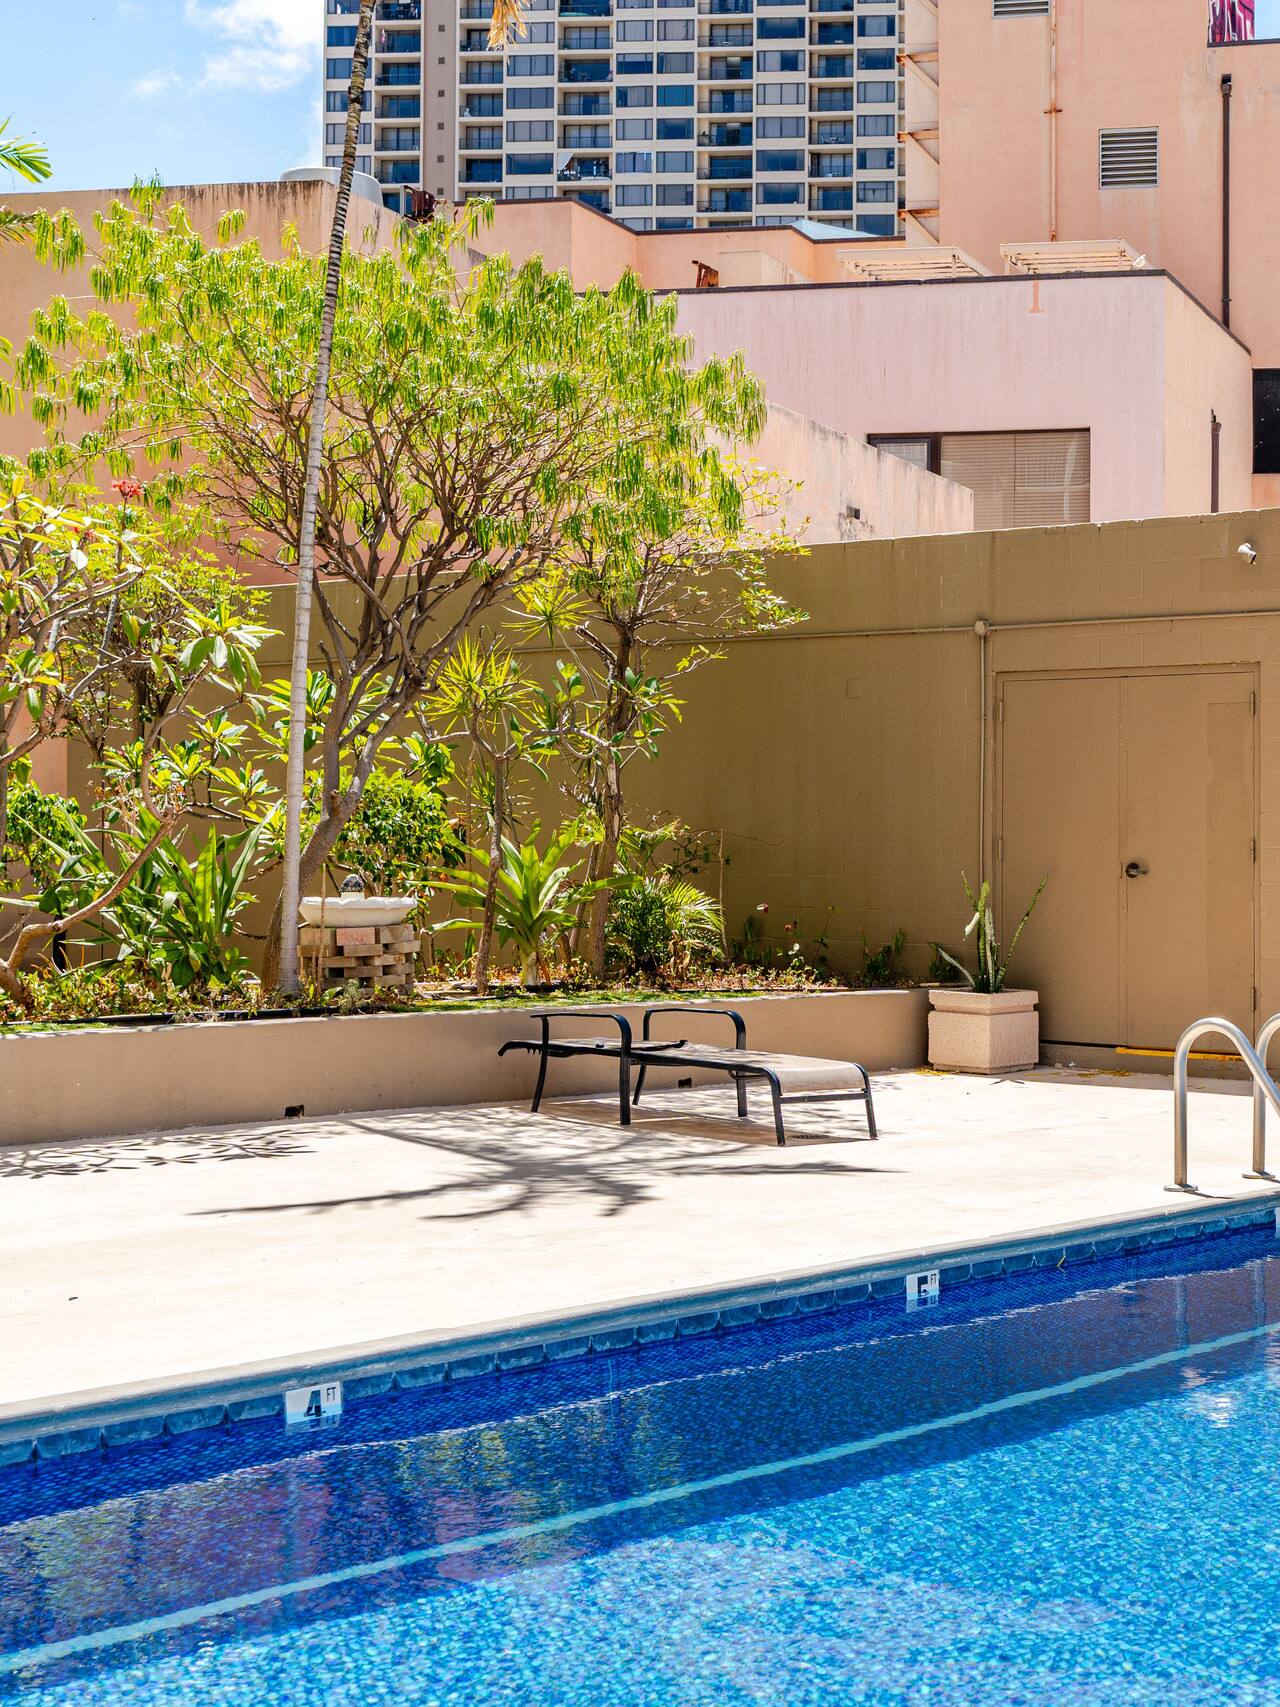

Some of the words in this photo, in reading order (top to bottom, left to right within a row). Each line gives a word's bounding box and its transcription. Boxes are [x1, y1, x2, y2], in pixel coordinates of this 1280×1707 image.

[931, 1273, 937, 1285] FT
[304, 1390, 326, 1417] 4
[327, 1387, 336, 1402] FT
